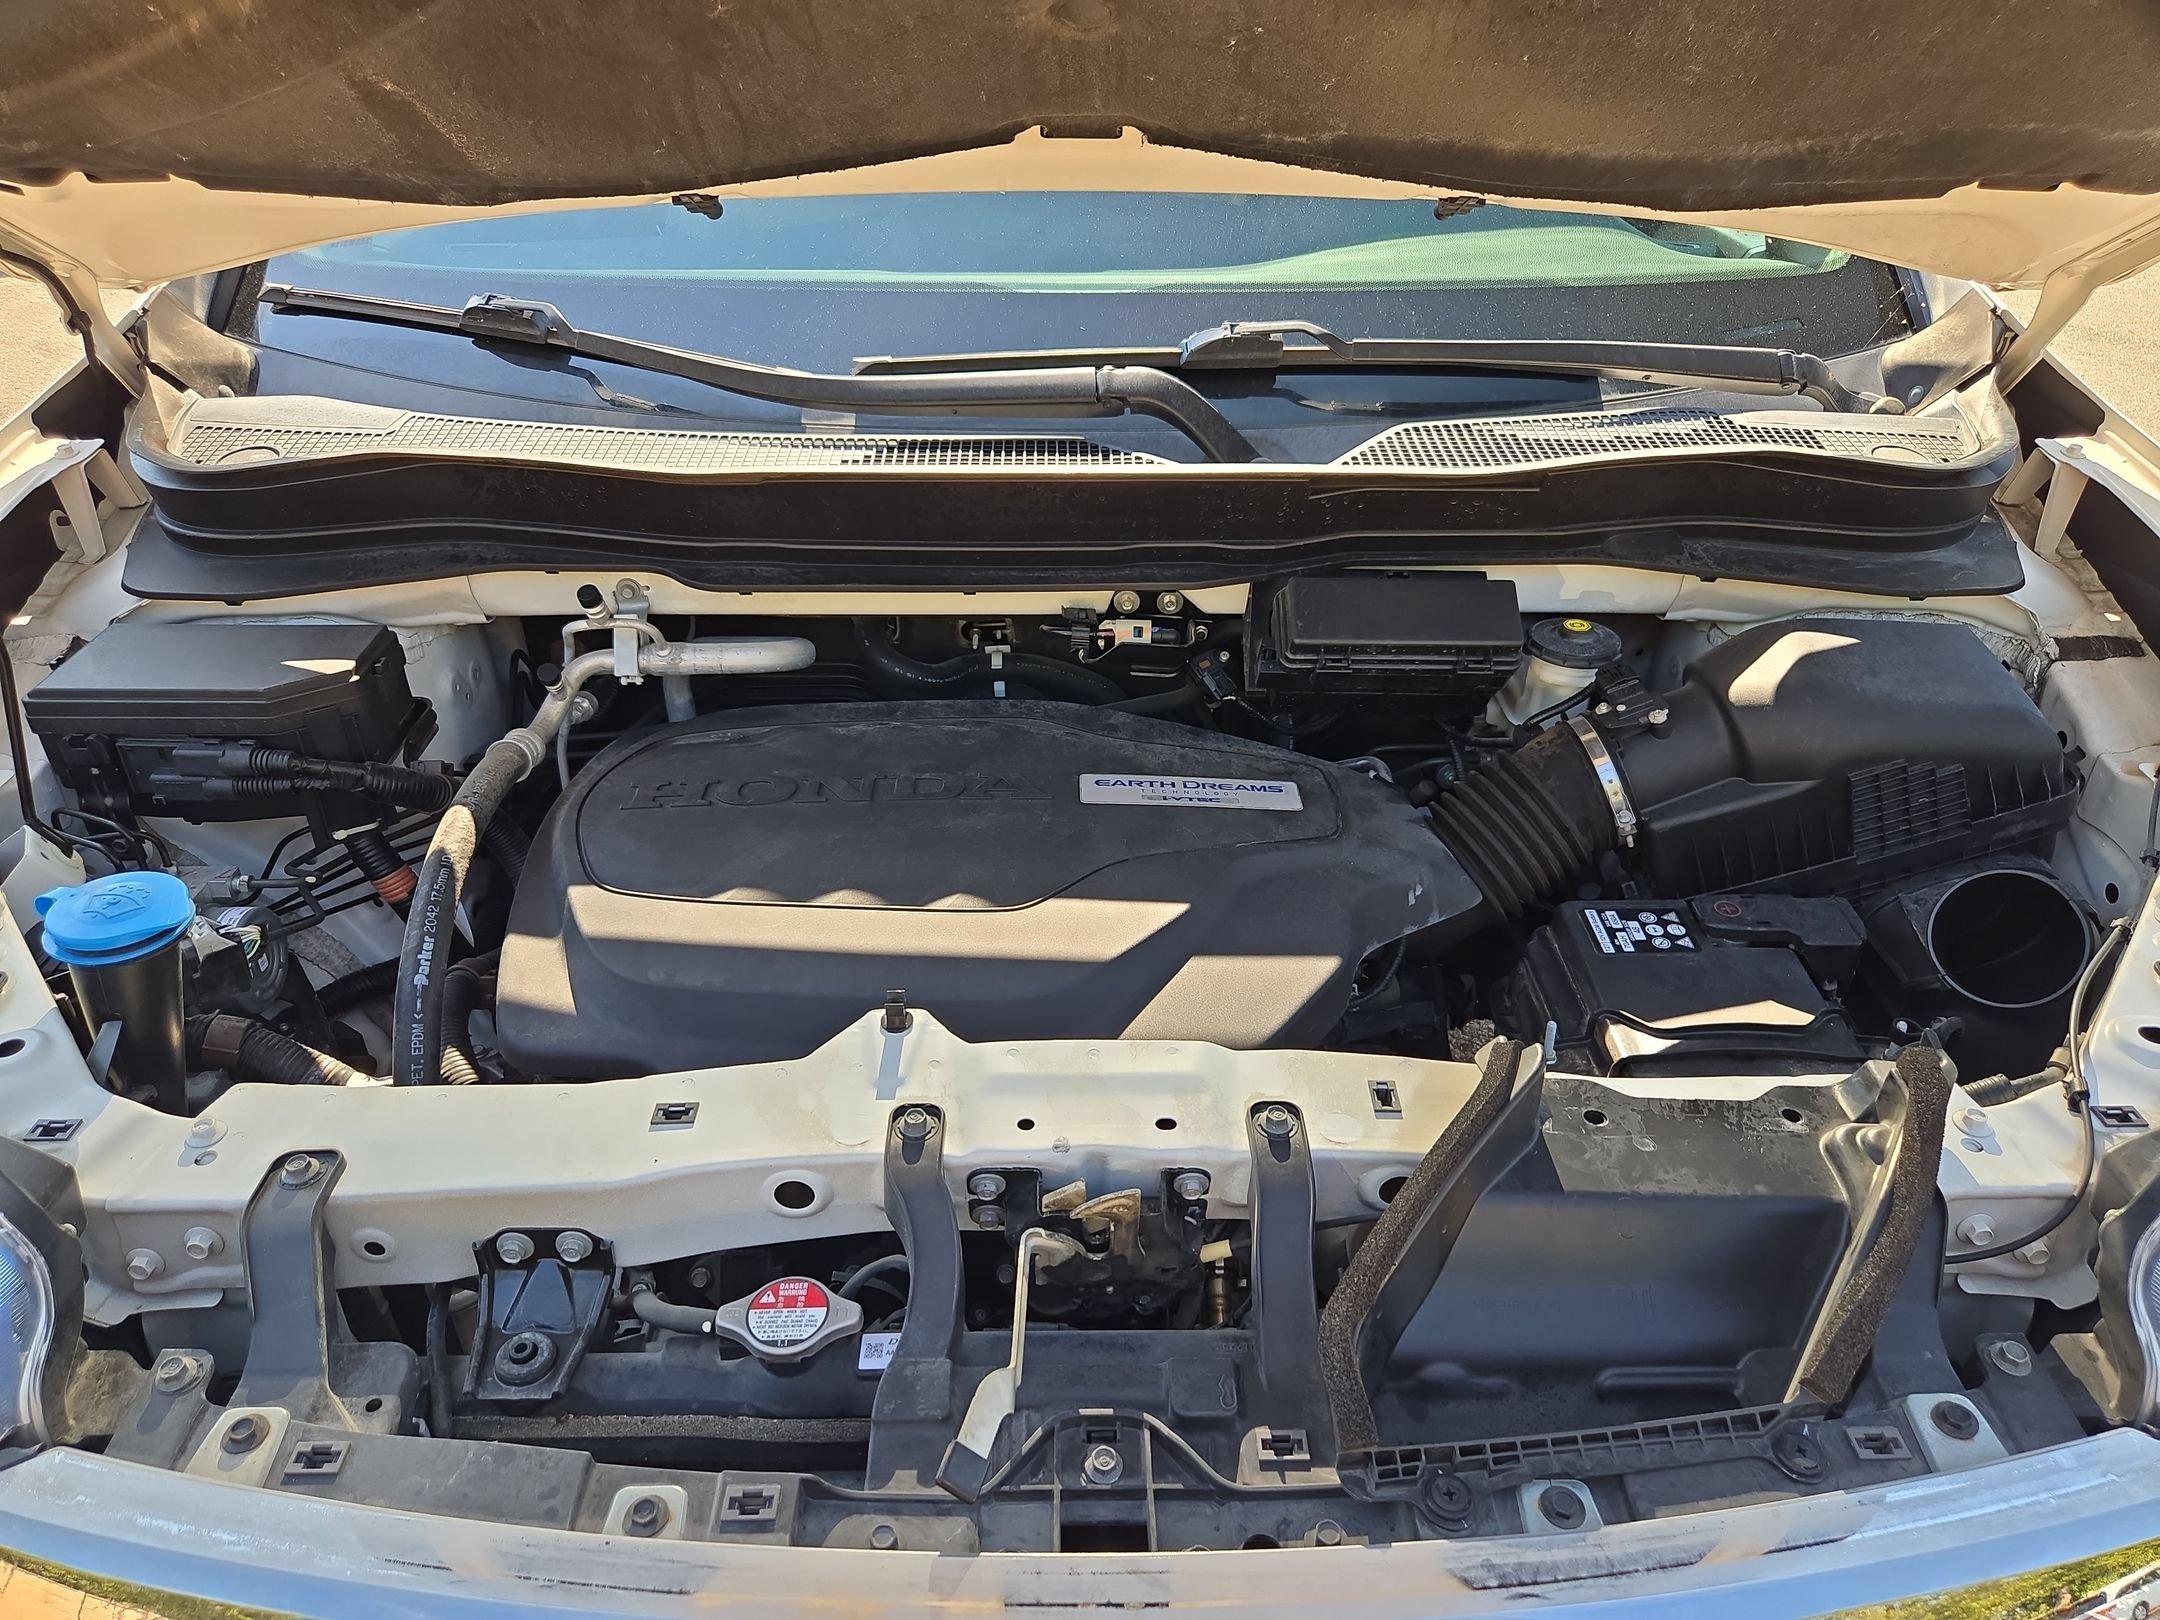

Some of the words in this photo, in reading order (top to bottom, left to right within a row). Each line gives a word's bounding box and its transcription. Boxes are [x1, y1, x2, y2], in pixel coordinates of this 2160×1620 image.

[620, 773, 1052, 810] HONDA
[1094, 779, 1176, 788] EARTH
[1182, 781, 1284, 793] DREAMS
[1140, 788, 1239, 796] TECHNOLOGY
[431, 870, 448, 901] 17.5mm
[424, 905, 440, 933] 2042
[414, 936, 435, 985] Parker
[411, 1023, 424, 1055] EPDM
